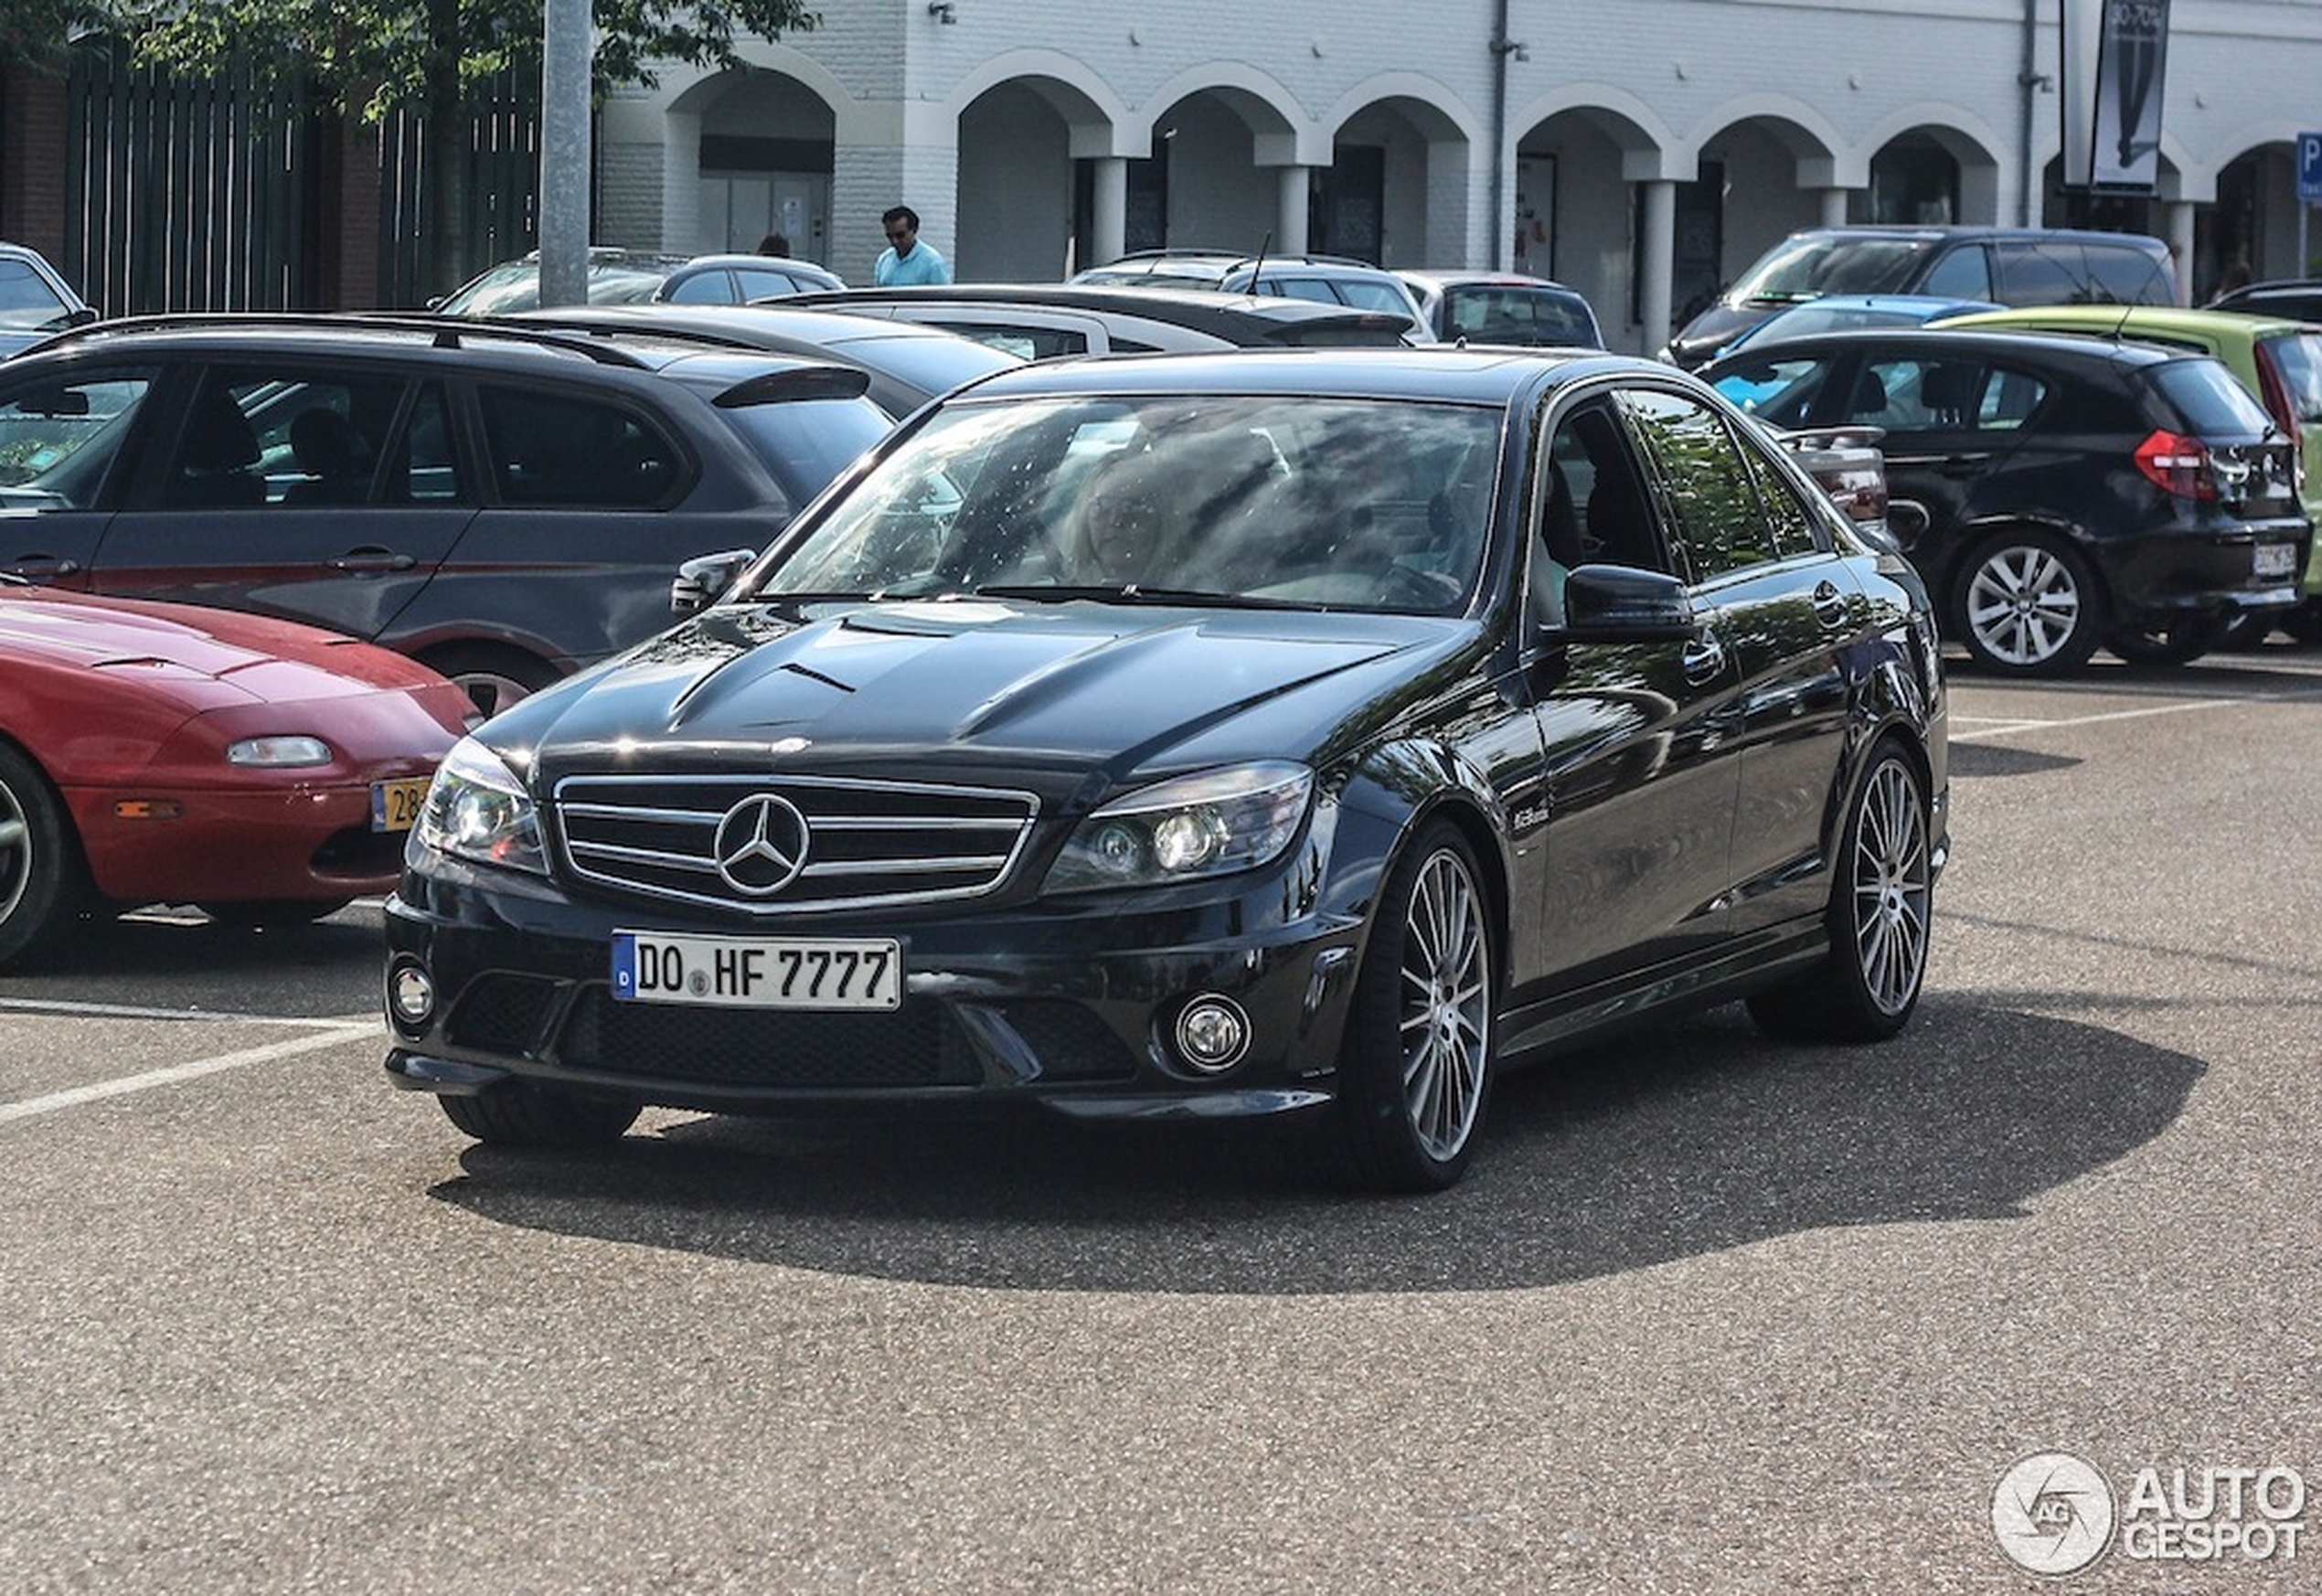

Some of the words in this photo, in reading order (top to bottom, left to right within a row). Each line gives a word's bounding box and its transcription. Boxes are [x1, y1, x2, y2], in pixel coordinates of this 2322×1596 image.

[2305, 138, 2320, 173] P
[619, 971, 630, 986] D
[638, 943, 683, 992] DO
[715, 949, 764, 995] HF
[779, 951, 889, 998] 7777
